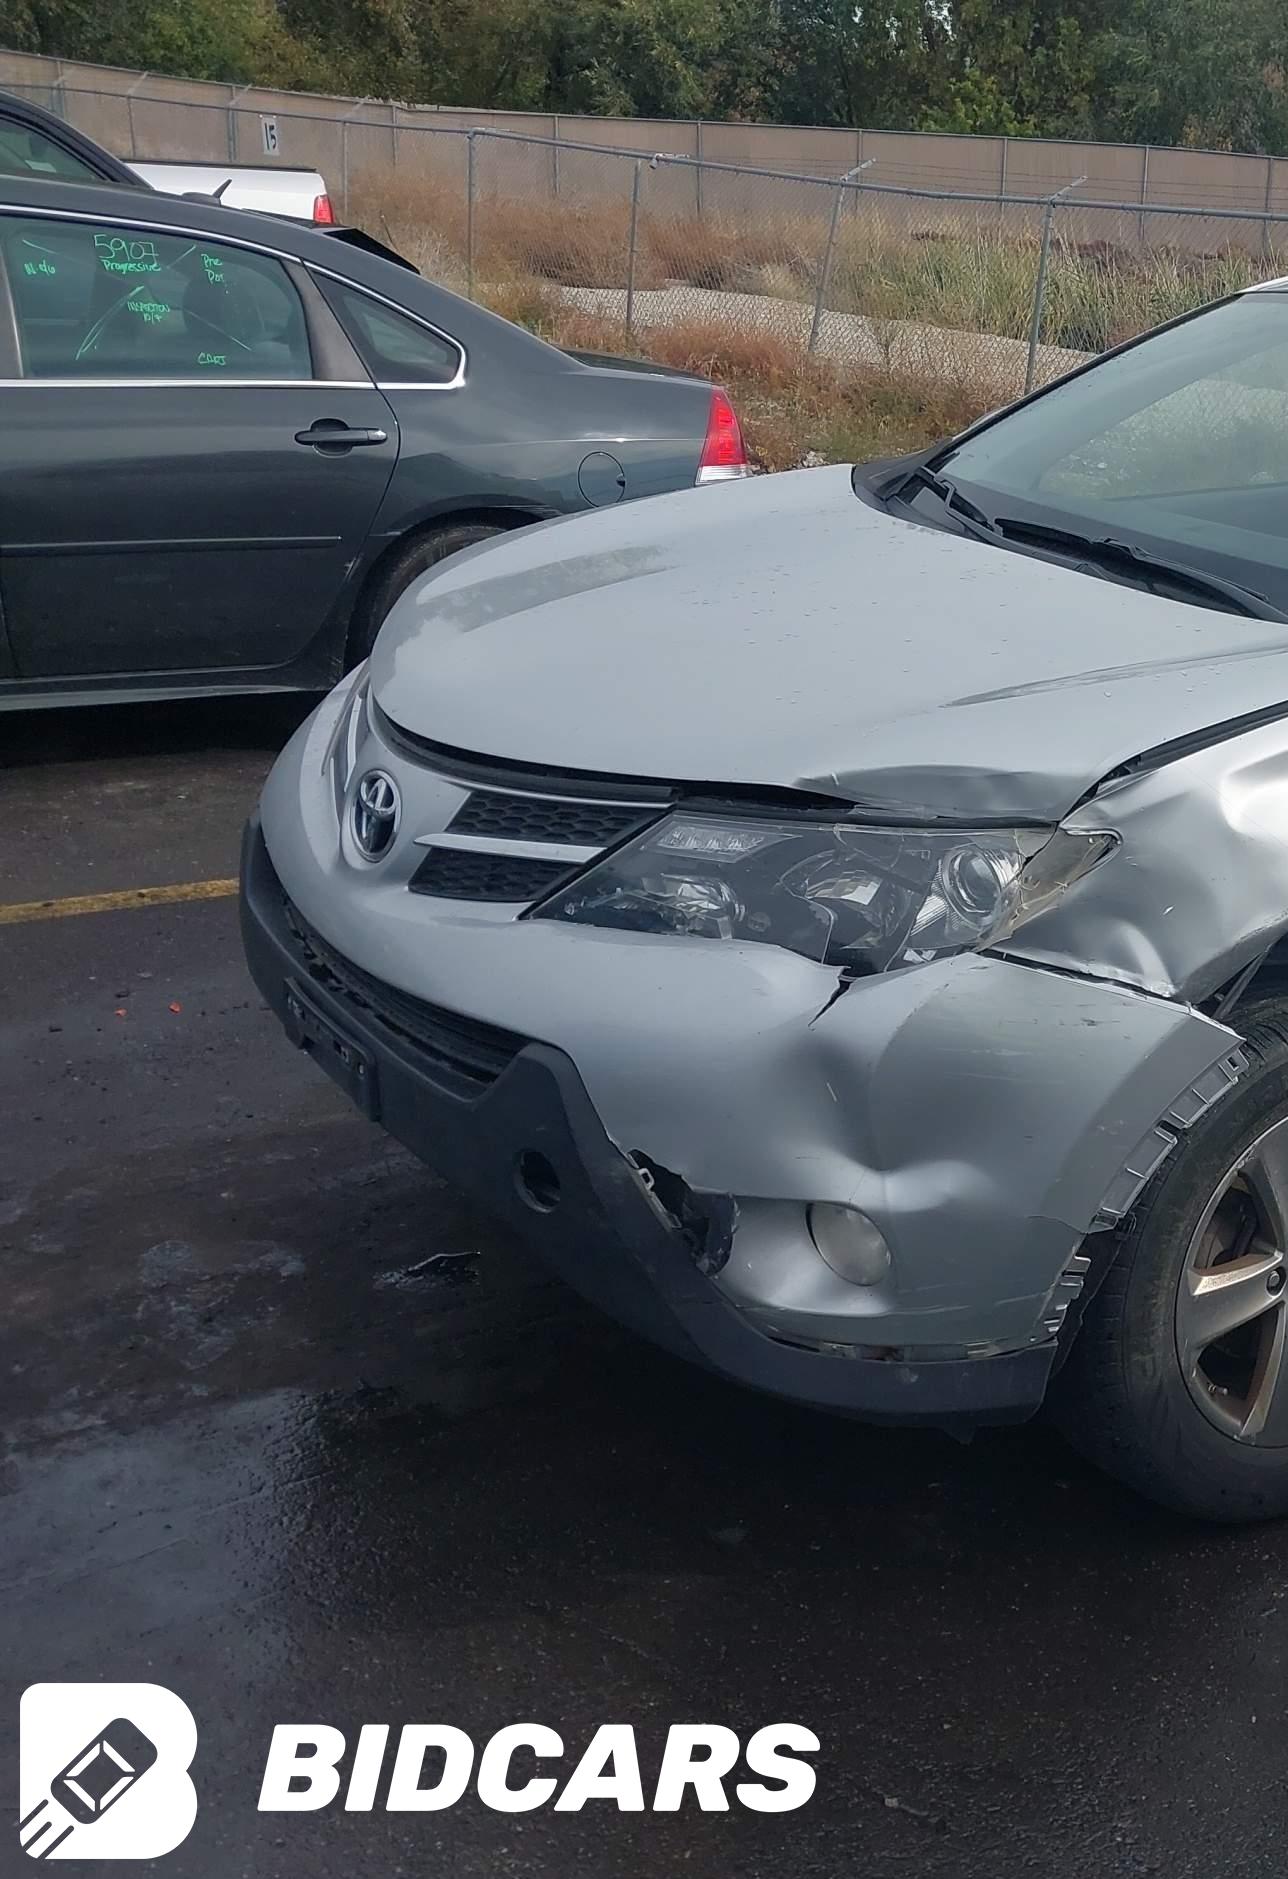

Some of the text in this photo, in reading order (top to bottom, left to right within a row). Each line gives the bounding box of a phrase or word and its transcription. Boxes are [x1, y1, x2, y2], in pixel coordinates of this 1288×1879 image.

[264, 122, 277, 151] 15
[94, 234, 159, 263] 5907
[101, 259, 161, 275] Progressive
